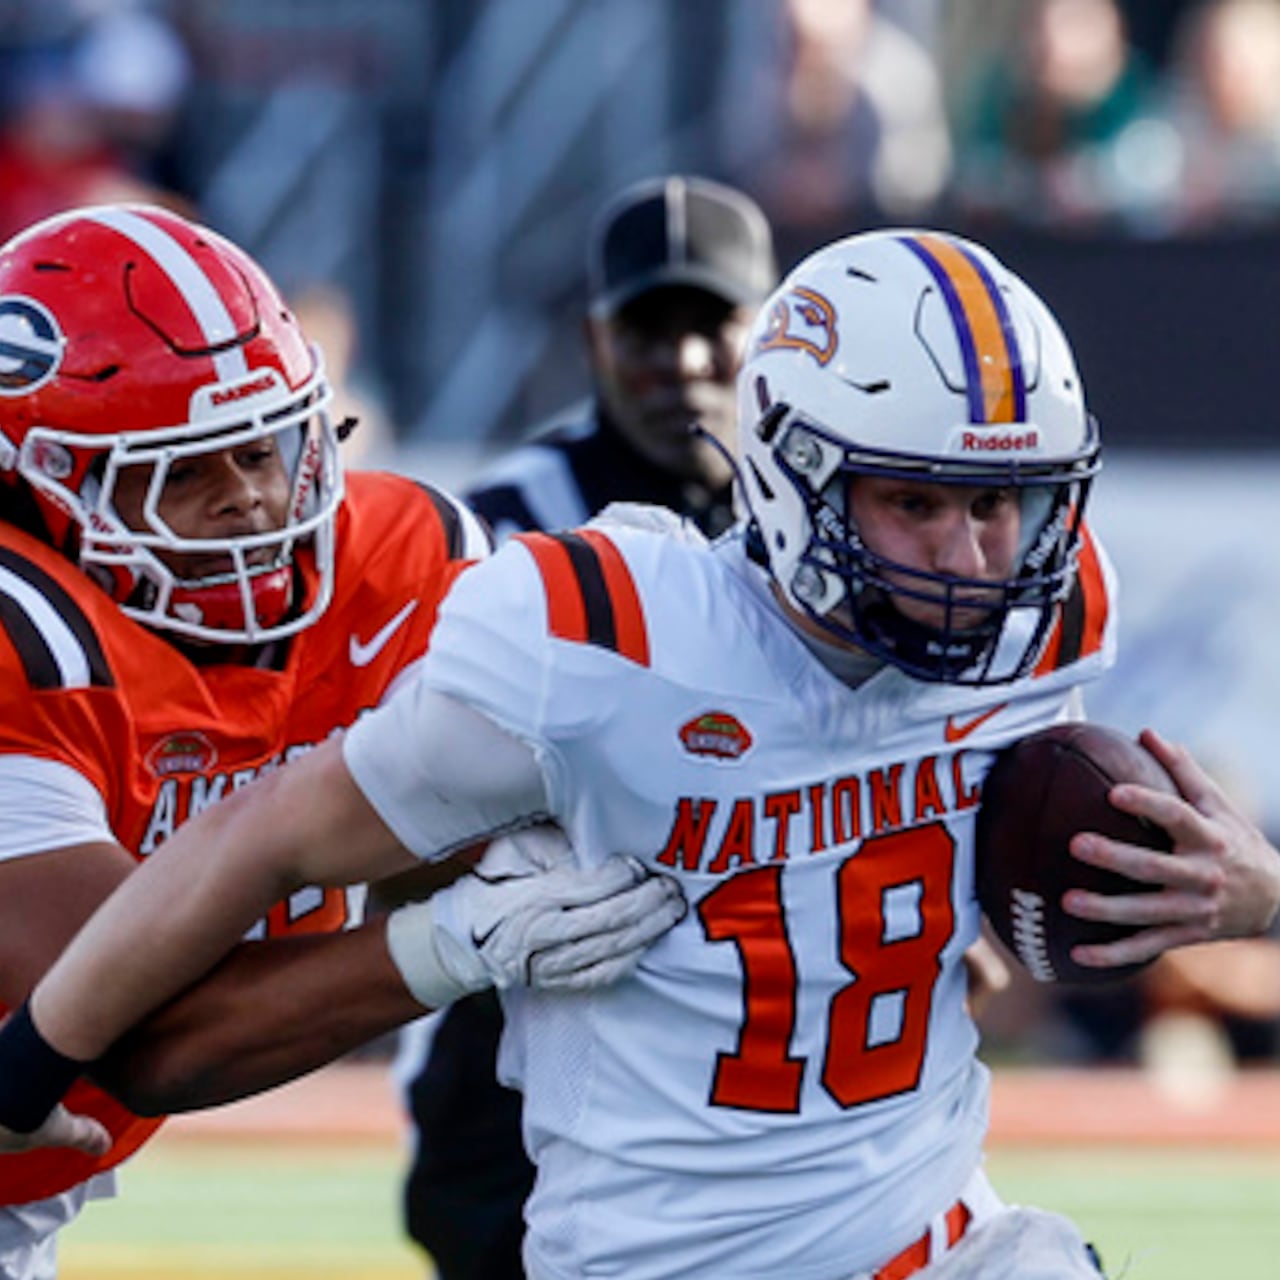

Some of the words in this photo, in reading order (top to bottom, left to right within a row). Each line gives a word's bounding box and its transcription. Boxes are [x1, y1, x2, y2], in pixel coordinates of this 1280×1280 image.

[961, 431, 1038, 451] Riddell
[656, 748, 979, 873] NATIONAL
[698, 821, 958, 1114] 18
